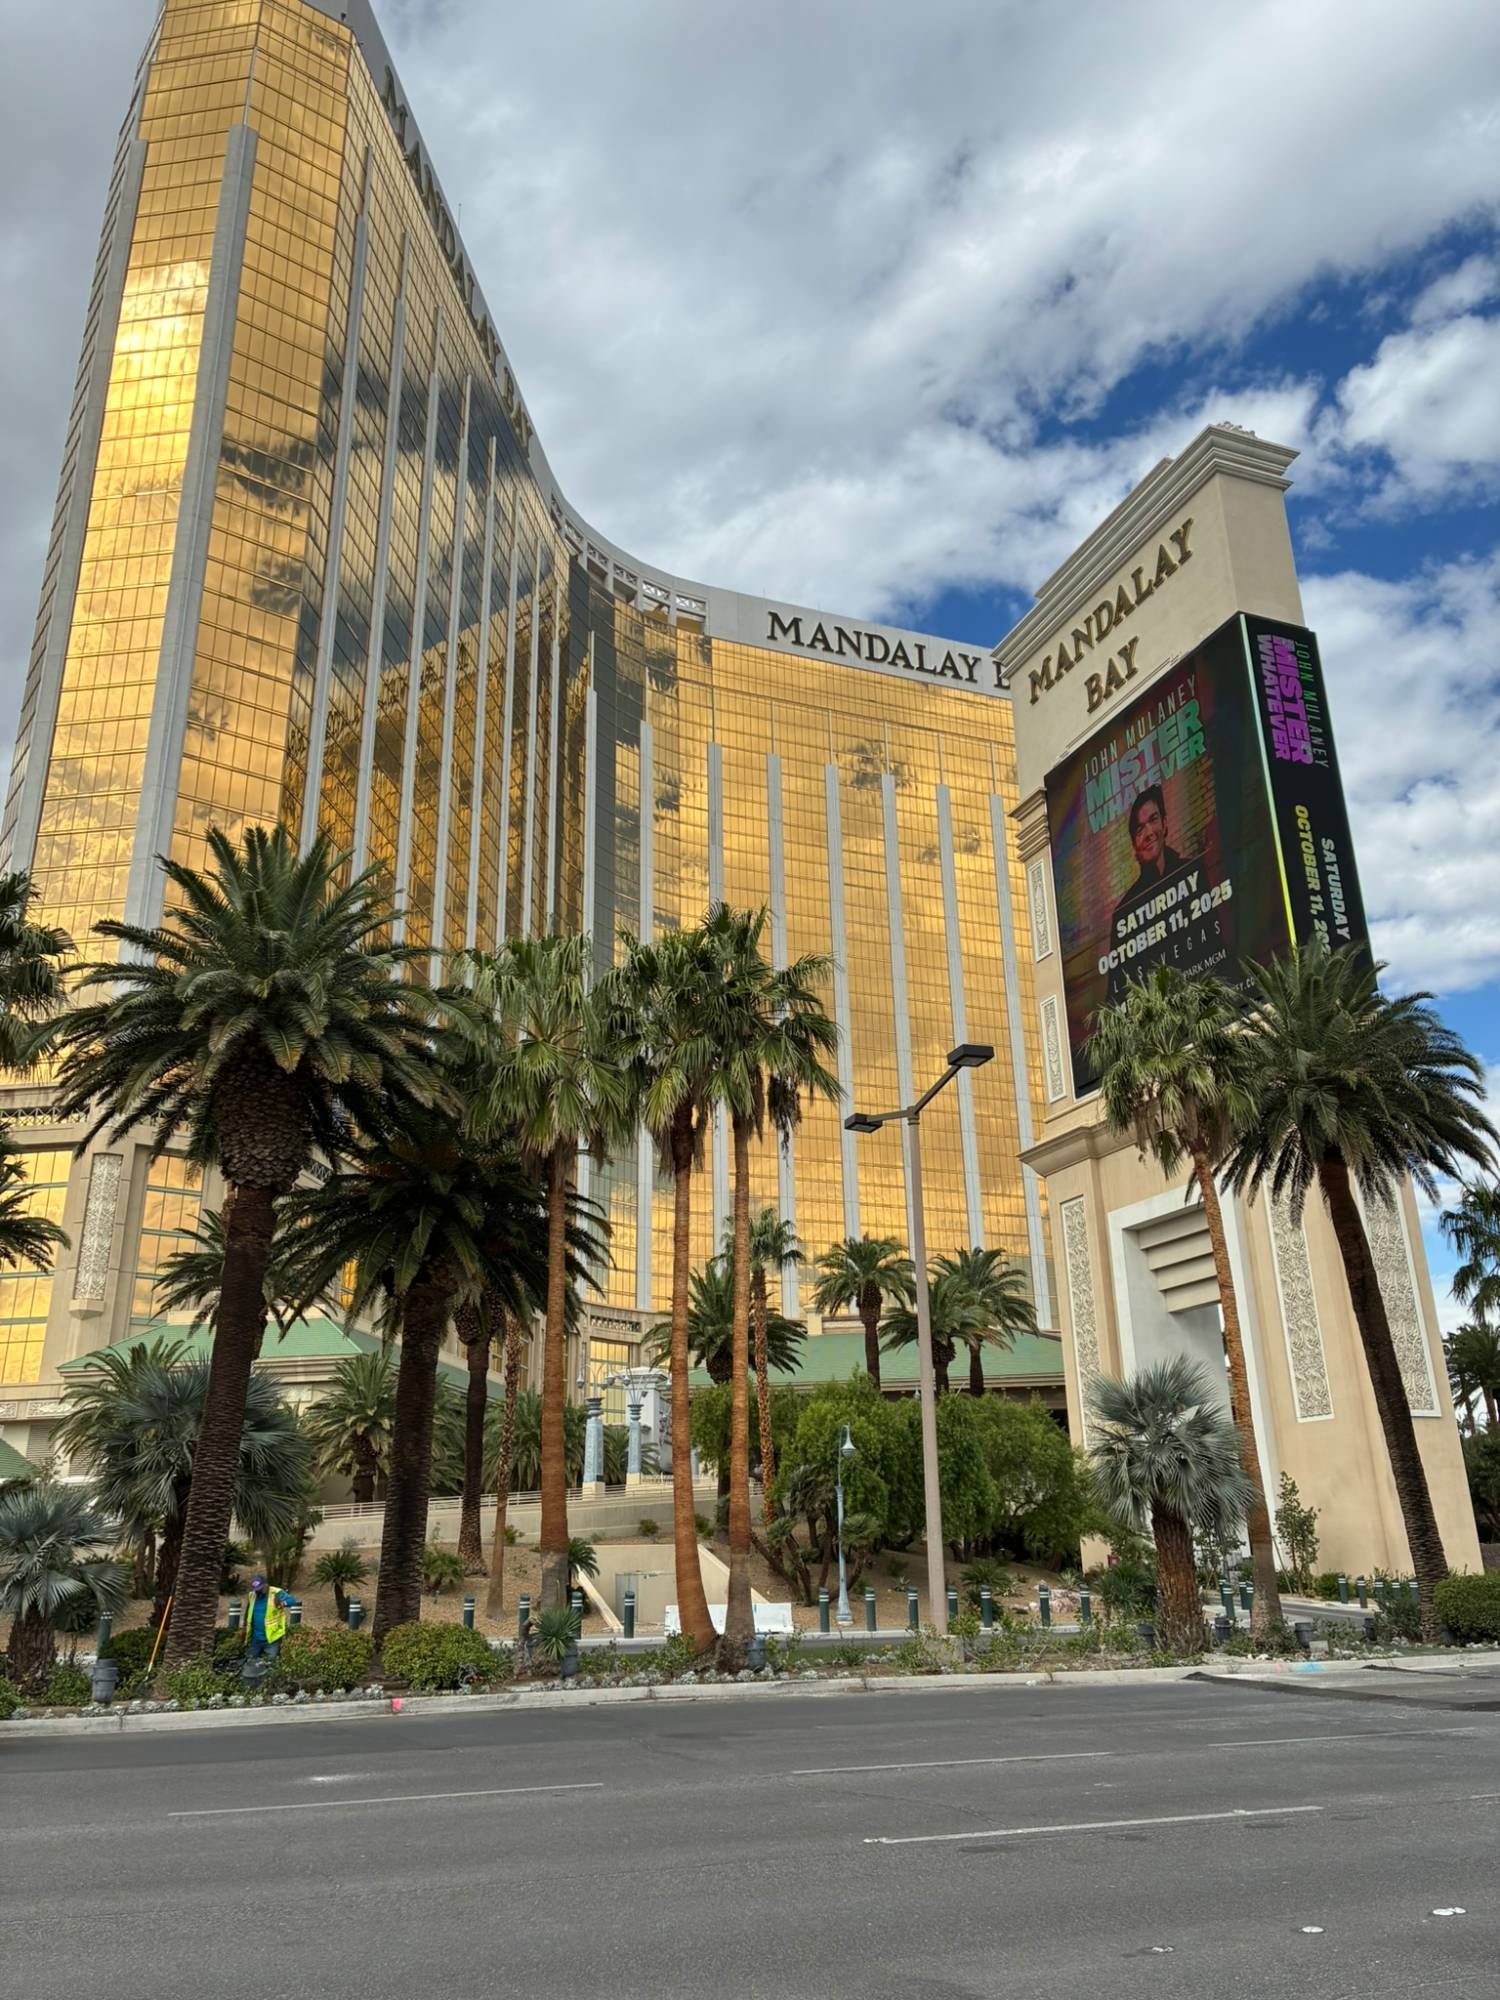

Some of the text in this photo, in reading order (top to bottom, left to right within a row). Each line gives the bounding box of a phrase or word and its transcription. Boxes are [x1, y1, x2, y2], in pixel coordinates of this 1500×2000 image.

[767, 611, 981, 683] MANDALAY
[1028, 517, 1194, 705] MANDALAY
[1084, 636, 1139, 713] BAY
[1257, 634, 1291, 760] WHATEVER
[1272, 635, 1313, 765] MISTER
[1295, 641, 1329, 768] JOHN MULANEY
[1084, 674, 1196, 781] JOHN MULANEY
[1086, 699, 1203, 815] MISTER
[1088, 731, 1206, 833] WHATEVER
[1295, 804, 1321, 891] OCTOBER
[1321, 837, 1351, 940] SATURDAY
[1098, 879, 1232, 975] OCTOBER 11, 2025
[1116, 871, 1199, 938] SATURDAY
[1160, 920, 1221, 965] VEGAS
